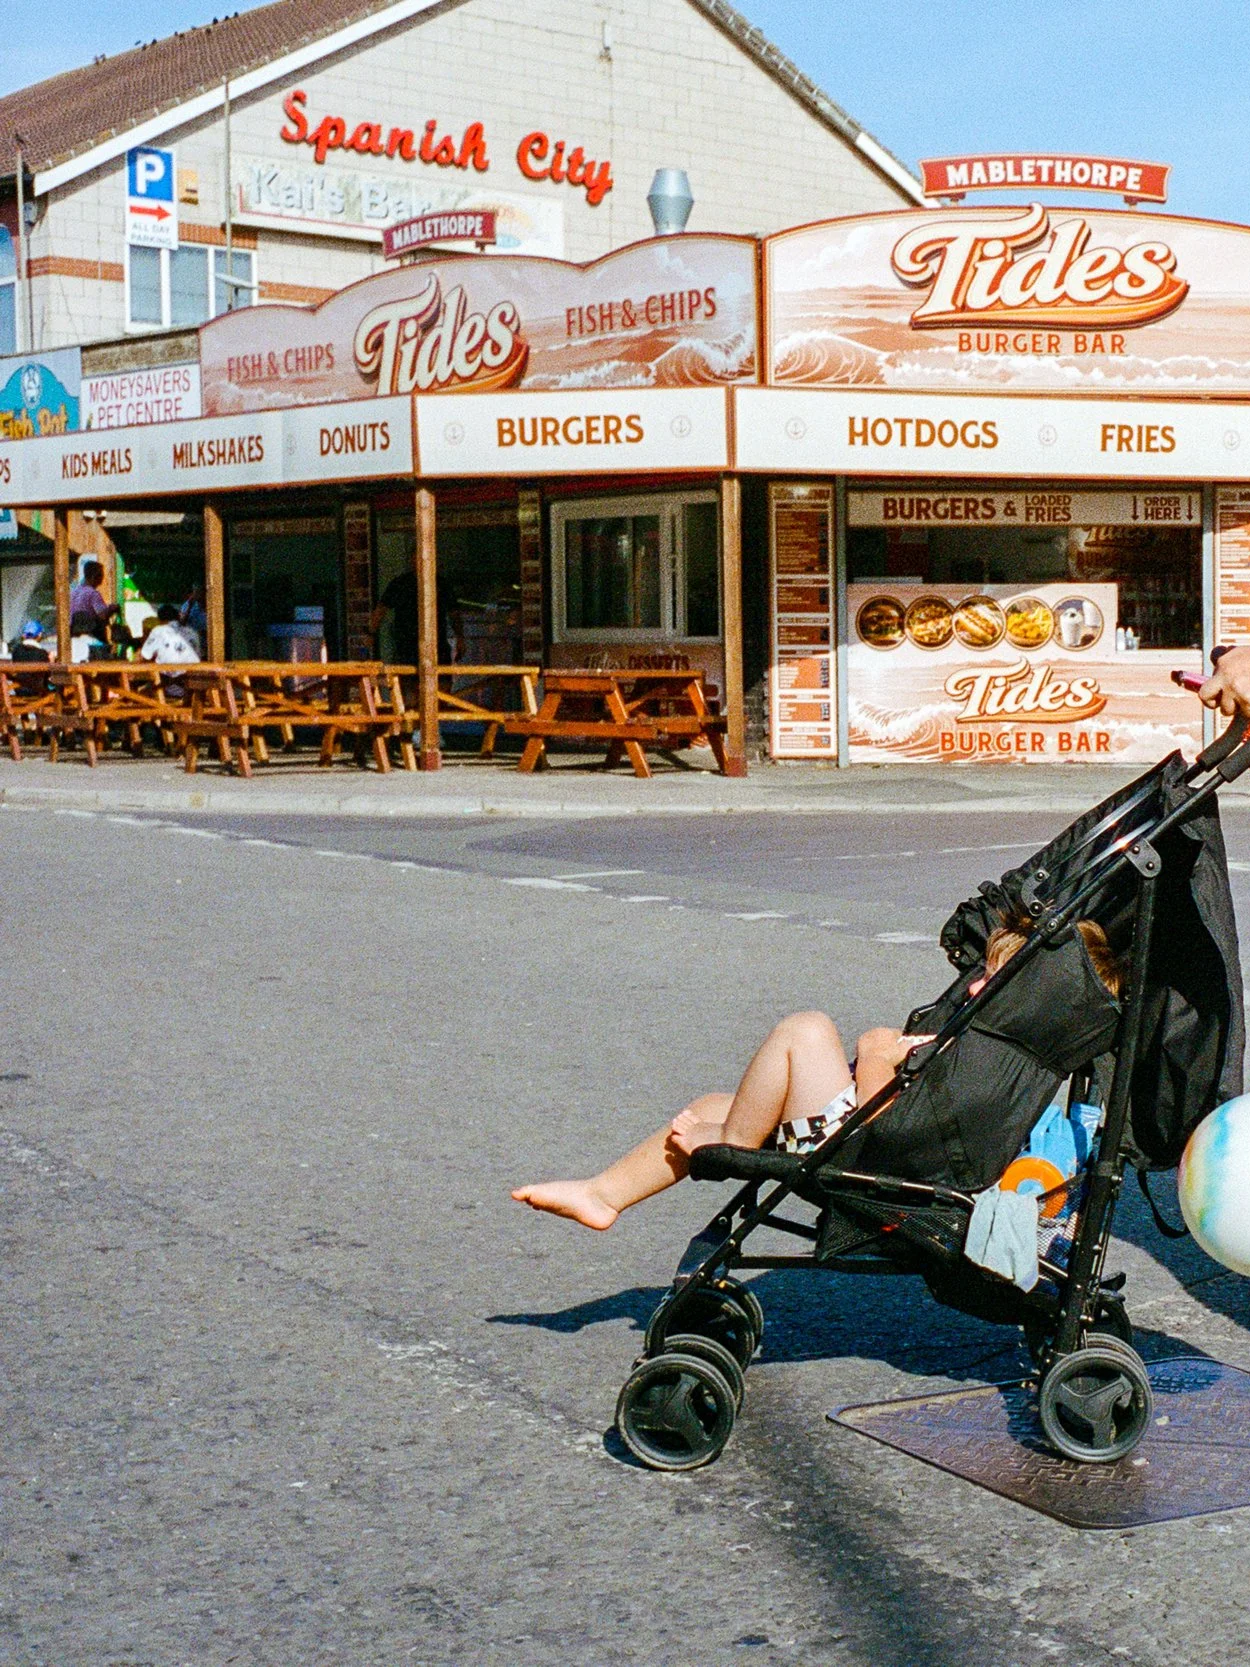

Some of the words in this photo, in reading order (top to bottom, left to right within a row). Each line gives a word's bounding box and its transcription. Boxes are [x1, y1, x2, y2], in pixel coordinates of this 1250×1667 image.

[280, 90, 490, 172] Spanish
[517, 131, 613, 206] City
[136, 153, 165, 194] P
[250, 165, 346, 215] Kai's
[946, 159, 1142, 191] MABLETHORPE
[391, 215, 484, 248] MABLETHORPE
[892, 203, 1182, 327] Tides
[566, 301, 614, 337] FISH
[620, 299, 638, 328] &
[645, 286, 718, 325] CHIPS
[354, 270, 522, 395] Tides
[959, 332, 1063, 354] BURGER
[1074, 333, 1126, 354] BAR
[226, 352, 263, 382] FISH
[267, 350, 280, 377] &
[284, 343, 335, 374] CHIPS
[89, 369, 192, 403] MONEYSAVERS
[97, 403, 123, 429] PET
[125, 398, 183, 426] CENTRE
[320, 422, 390, 455] DONUTS
[497, 414, 645, 447] BURGERS
[847, 417, 999, 450] HOTDOGS
[1101, 424, 1177, 454] FRIES
[62, 451, 88, 479] KIDS
[91, 448, 133, 476] MEALS
[172, 435, 264, 470] MILKSHAKES
[882, 497, 997, 521] BURGERS
[1003, 500, 1017, 518] &
[1024, 494, 1072, 507] LOADED
[1024, 506, 1072, 523] FRIES
[1143, 495, 1181, 508] ORDER
[1144, 507, 1181, 521] HERE
[944, 656, 1104, 722] Tides
[940, 731, 1046, 752] BURGER
[1058, 731, 1111, 752] BAR
